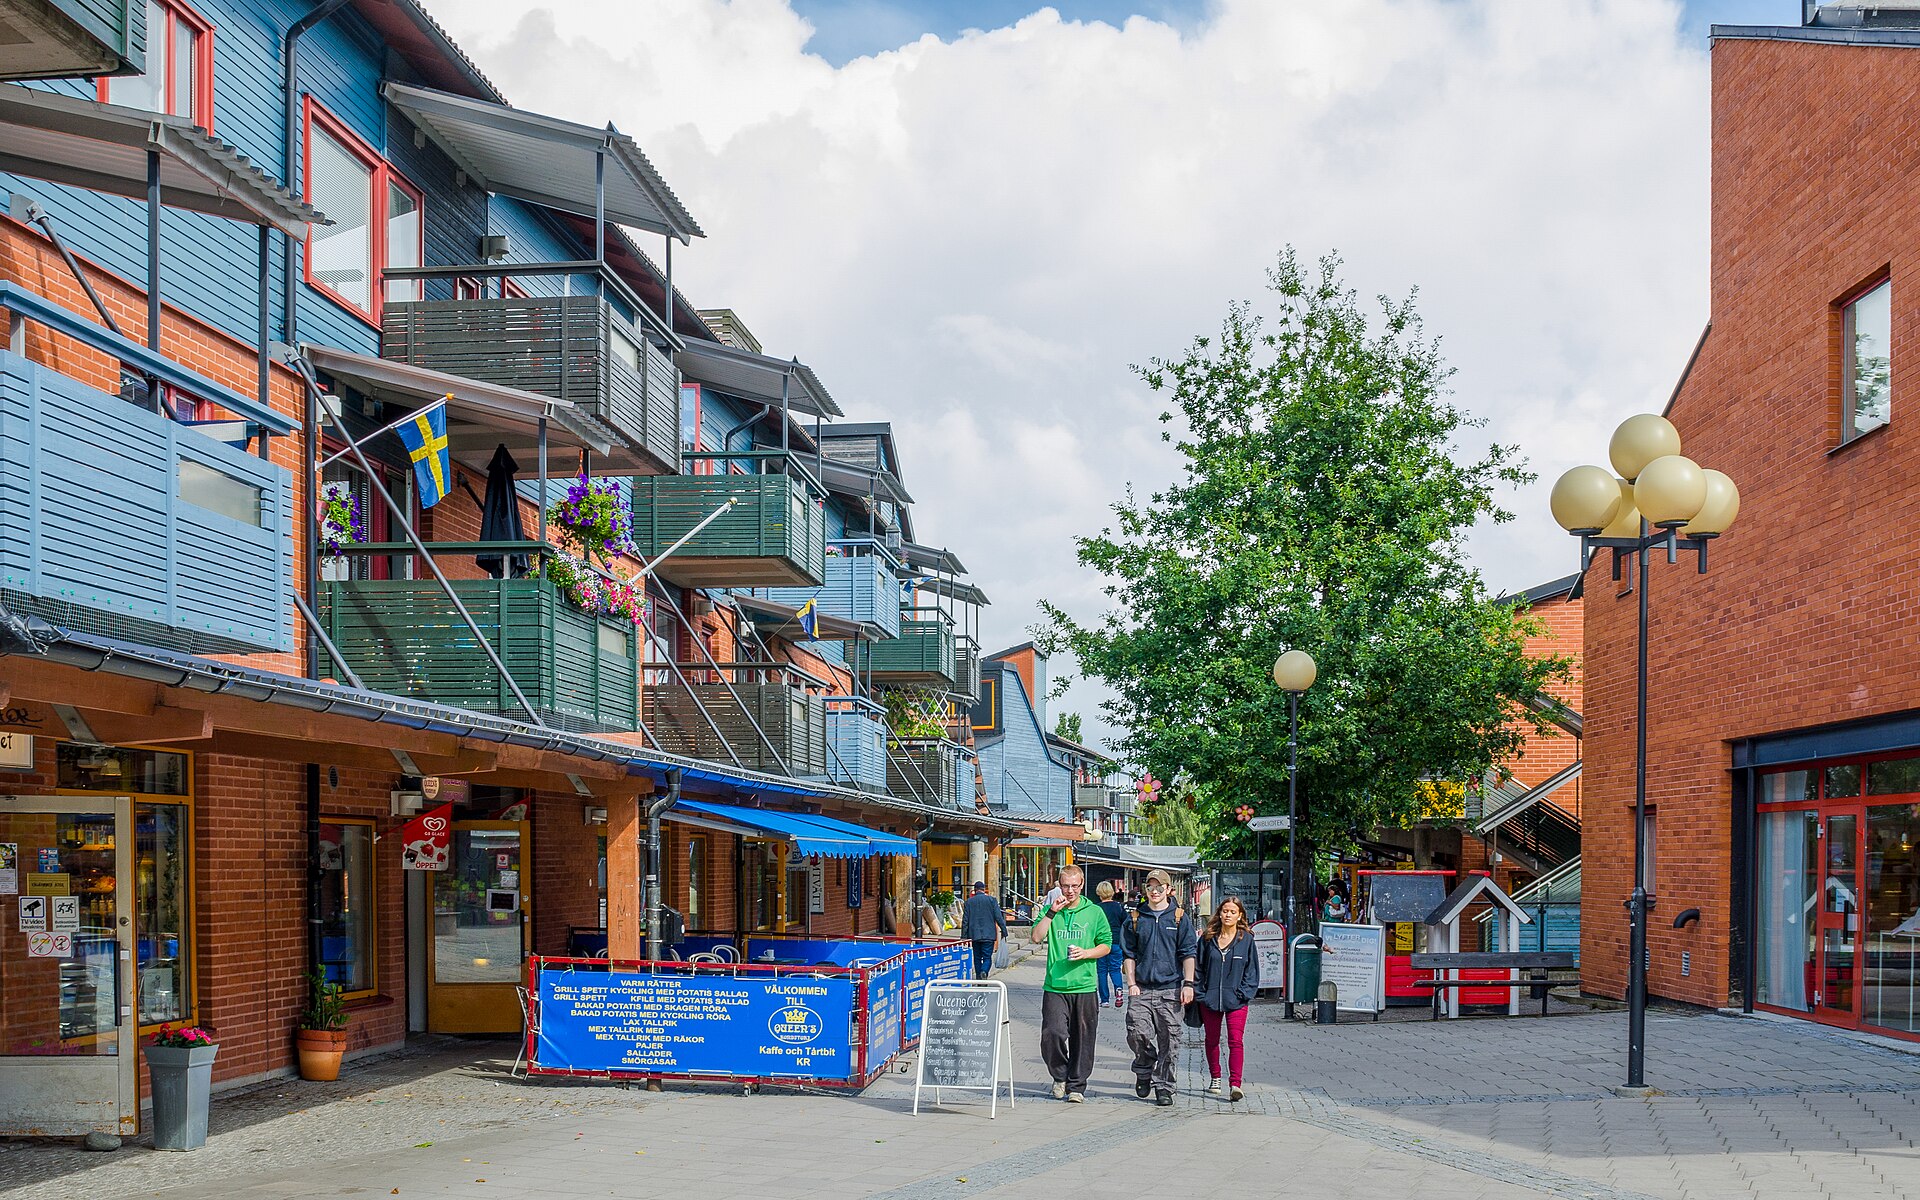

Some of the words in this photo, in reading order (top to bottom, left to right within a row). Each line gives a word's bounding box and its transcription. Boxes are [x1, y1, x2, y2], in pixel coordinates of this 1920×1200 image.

[1057, 930, 1081, 939] PUMA
[647, 979, 681, 988] RÄTTER
[656, 988, 674, 996] MED
[677, 989, 712, 997] POTATIS
[765, 985, 827, 995] VÄLKOMMEN
[786, 997, 806, 1005] TILL
[936, 995, 966, 1007] Queens
[665, 1004, 700, 1012] SKAGEN
[703, 1005, 727, 1013] RÖRA
[707, 1012, 731, 1020] RÖRA
[674, 1035, 704, 1043] RÄKOR
[759, 1046, 783, 1054] Kaffe
[786, 1047, 802, 1055] och
[805, 1047, 835, 1056] Tårtbit
[622, 1057, 676, 1065] SMÖRGÅSAR
[797, 1058, 810, 1066] KR
